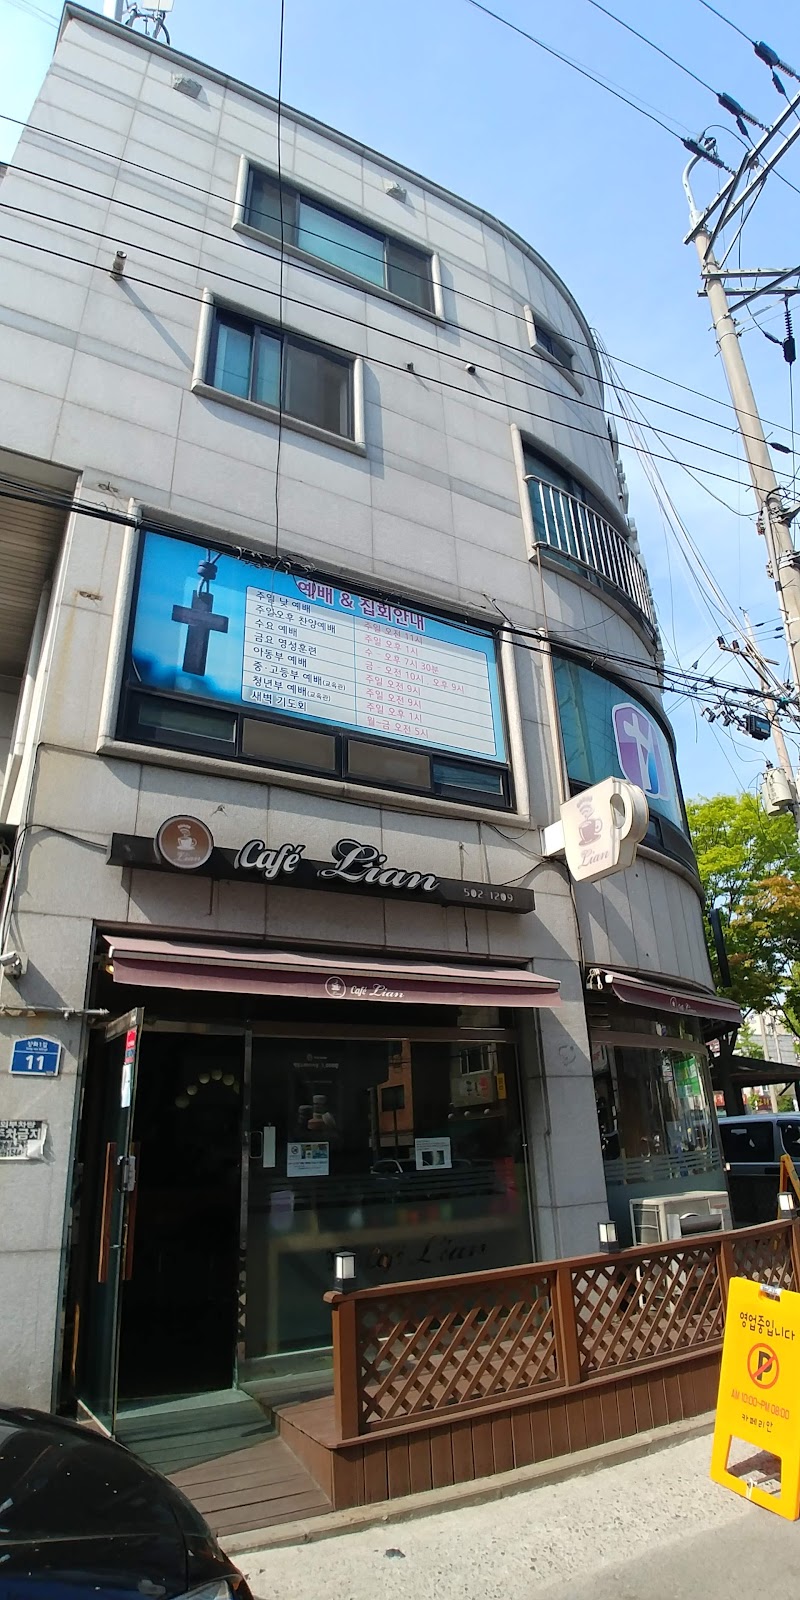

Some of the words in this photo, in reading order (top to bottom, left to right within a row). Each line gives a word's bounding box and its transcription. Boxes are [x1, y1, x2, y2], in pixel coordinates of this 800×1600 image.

[255, 590, 275, 603] 주일
[291, 601, 312, 614] 예배
[298, 580, 333, 604] 예배
[340, 591, 354, 609] &
[359, 597, 425, 631] 집회안내
[255, 619, 274, 630] 수요
[277, 625, 298, 637] 예배
[298, 615, 336, 634] 찬양예배
[364, 622, 381, 633] 주일
[385, 627, 401, 639] 오전
[405, 633, 423, 645] 11시
[254, 632, 274, 645] 금요
[278, 638, 317, 656] 영성훈련
[364, 635, 381, 647] 주일
[385, 640, 401, 651] 오후
[406, 645, 419, 657] 1시
[253, 646, 284, 661] 아동부
[287, 655, 307, 668] 예배
[365, 648, 373, 657] 수
[384, 652, 401, 664] 오후
[405, 657, 418, 669] 7시
[421, 663, 440, 675] 30분
[252, 675, 283, 691] 청년부
[365, 661, 373, 671] 금
[385, 666, 402, 678] 오전
[405, 671, 424, 684] 10시
[433, 678, 449, 689] 오후
[451, 682, 465, 695] 9시
[366, 674, 383, 686] 주일
[387, 680, 404, 691] 오전
[406, 684, 421, 696] 9시
[252, 691, 272, 704] 새벽
[277, 697, 307, 712] 기도회
[366, 688, 383, 700] 주일
[388, 693, 404, 706] 오전
[407, 698, 422, 710] 9시
[367, 702, 384, 714] 주일
[388, 707, 405, 719] 오후
[409, 712, 422, 723] 1시
[394, 722, 411, 734] 오전
[414, 726, 429, 739] 5시
[237, 840, 306, 880] Café
[318, 838, 440, 891] Lian
[577, 848, 610, 870] Lian
[463, 888, 484, 899] 502
[490, 889, 514, 903] 1209
[350, 985, 367, 997] Café
[368, 983, 405, 998] Lian
[25, 1054, 45, 1071] 11
[739, 1311, 796, 1341] 영업중입니다
[731, 1389, 740, 1400] AM
[771, 1407, 790, 1420] 08:00
